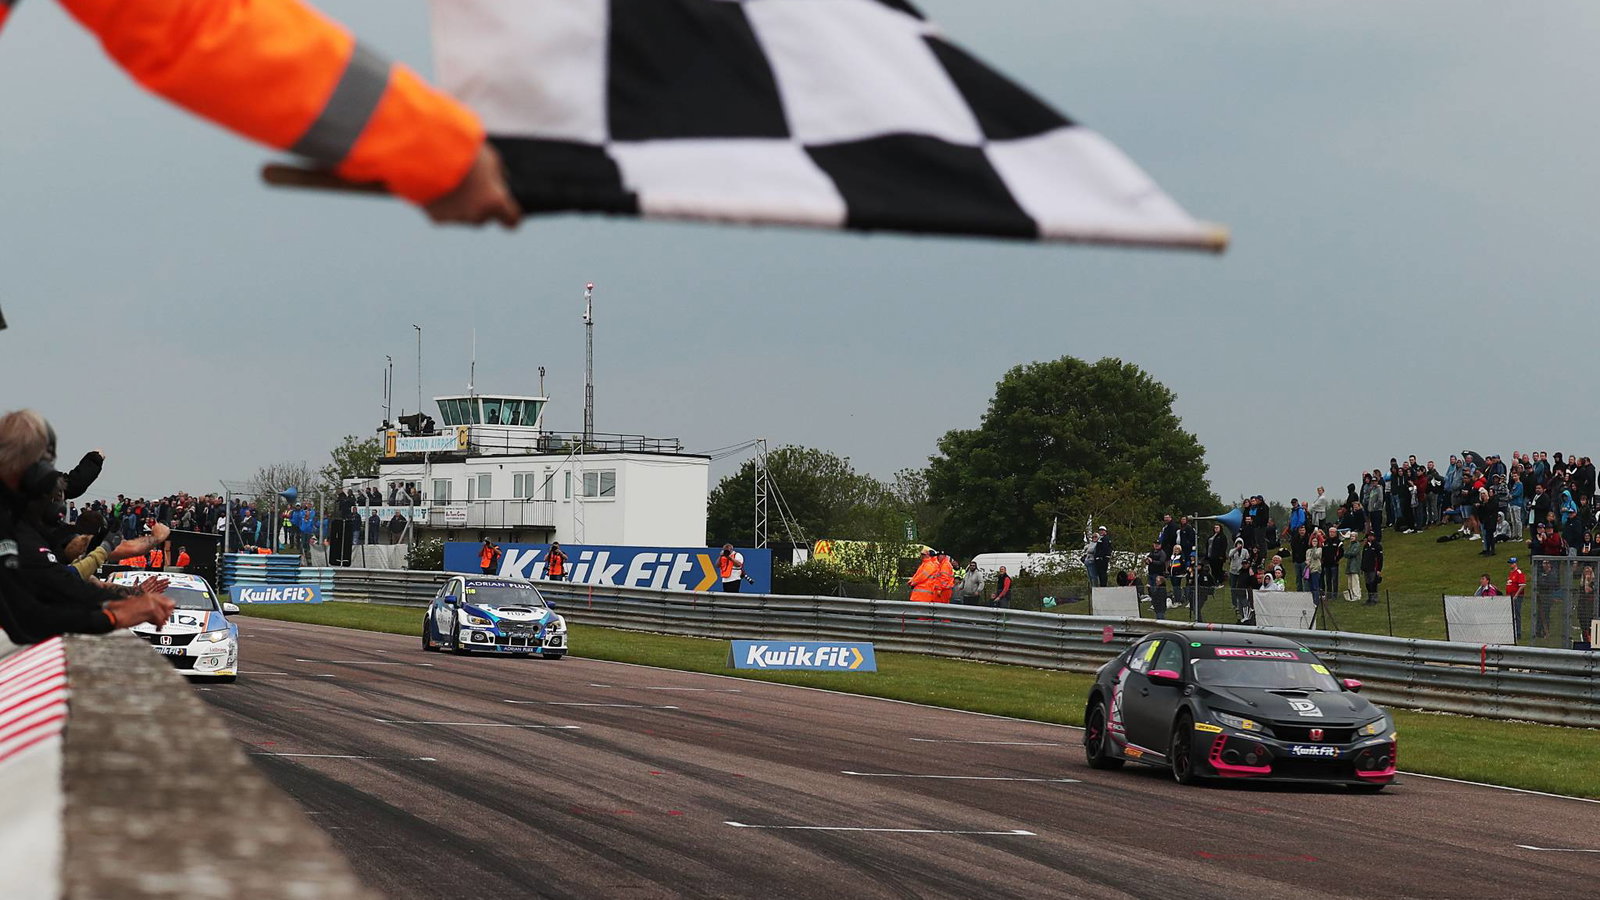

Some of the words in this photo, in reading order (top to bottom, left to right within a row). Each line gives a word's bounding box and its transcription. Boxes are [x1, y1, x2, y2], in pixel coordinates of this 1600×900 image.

[398, 439, 429, 450] THRUXTON
[431, 438, 456, 449] AIRPORT
[1247, 650, 1292, 658] RACING
